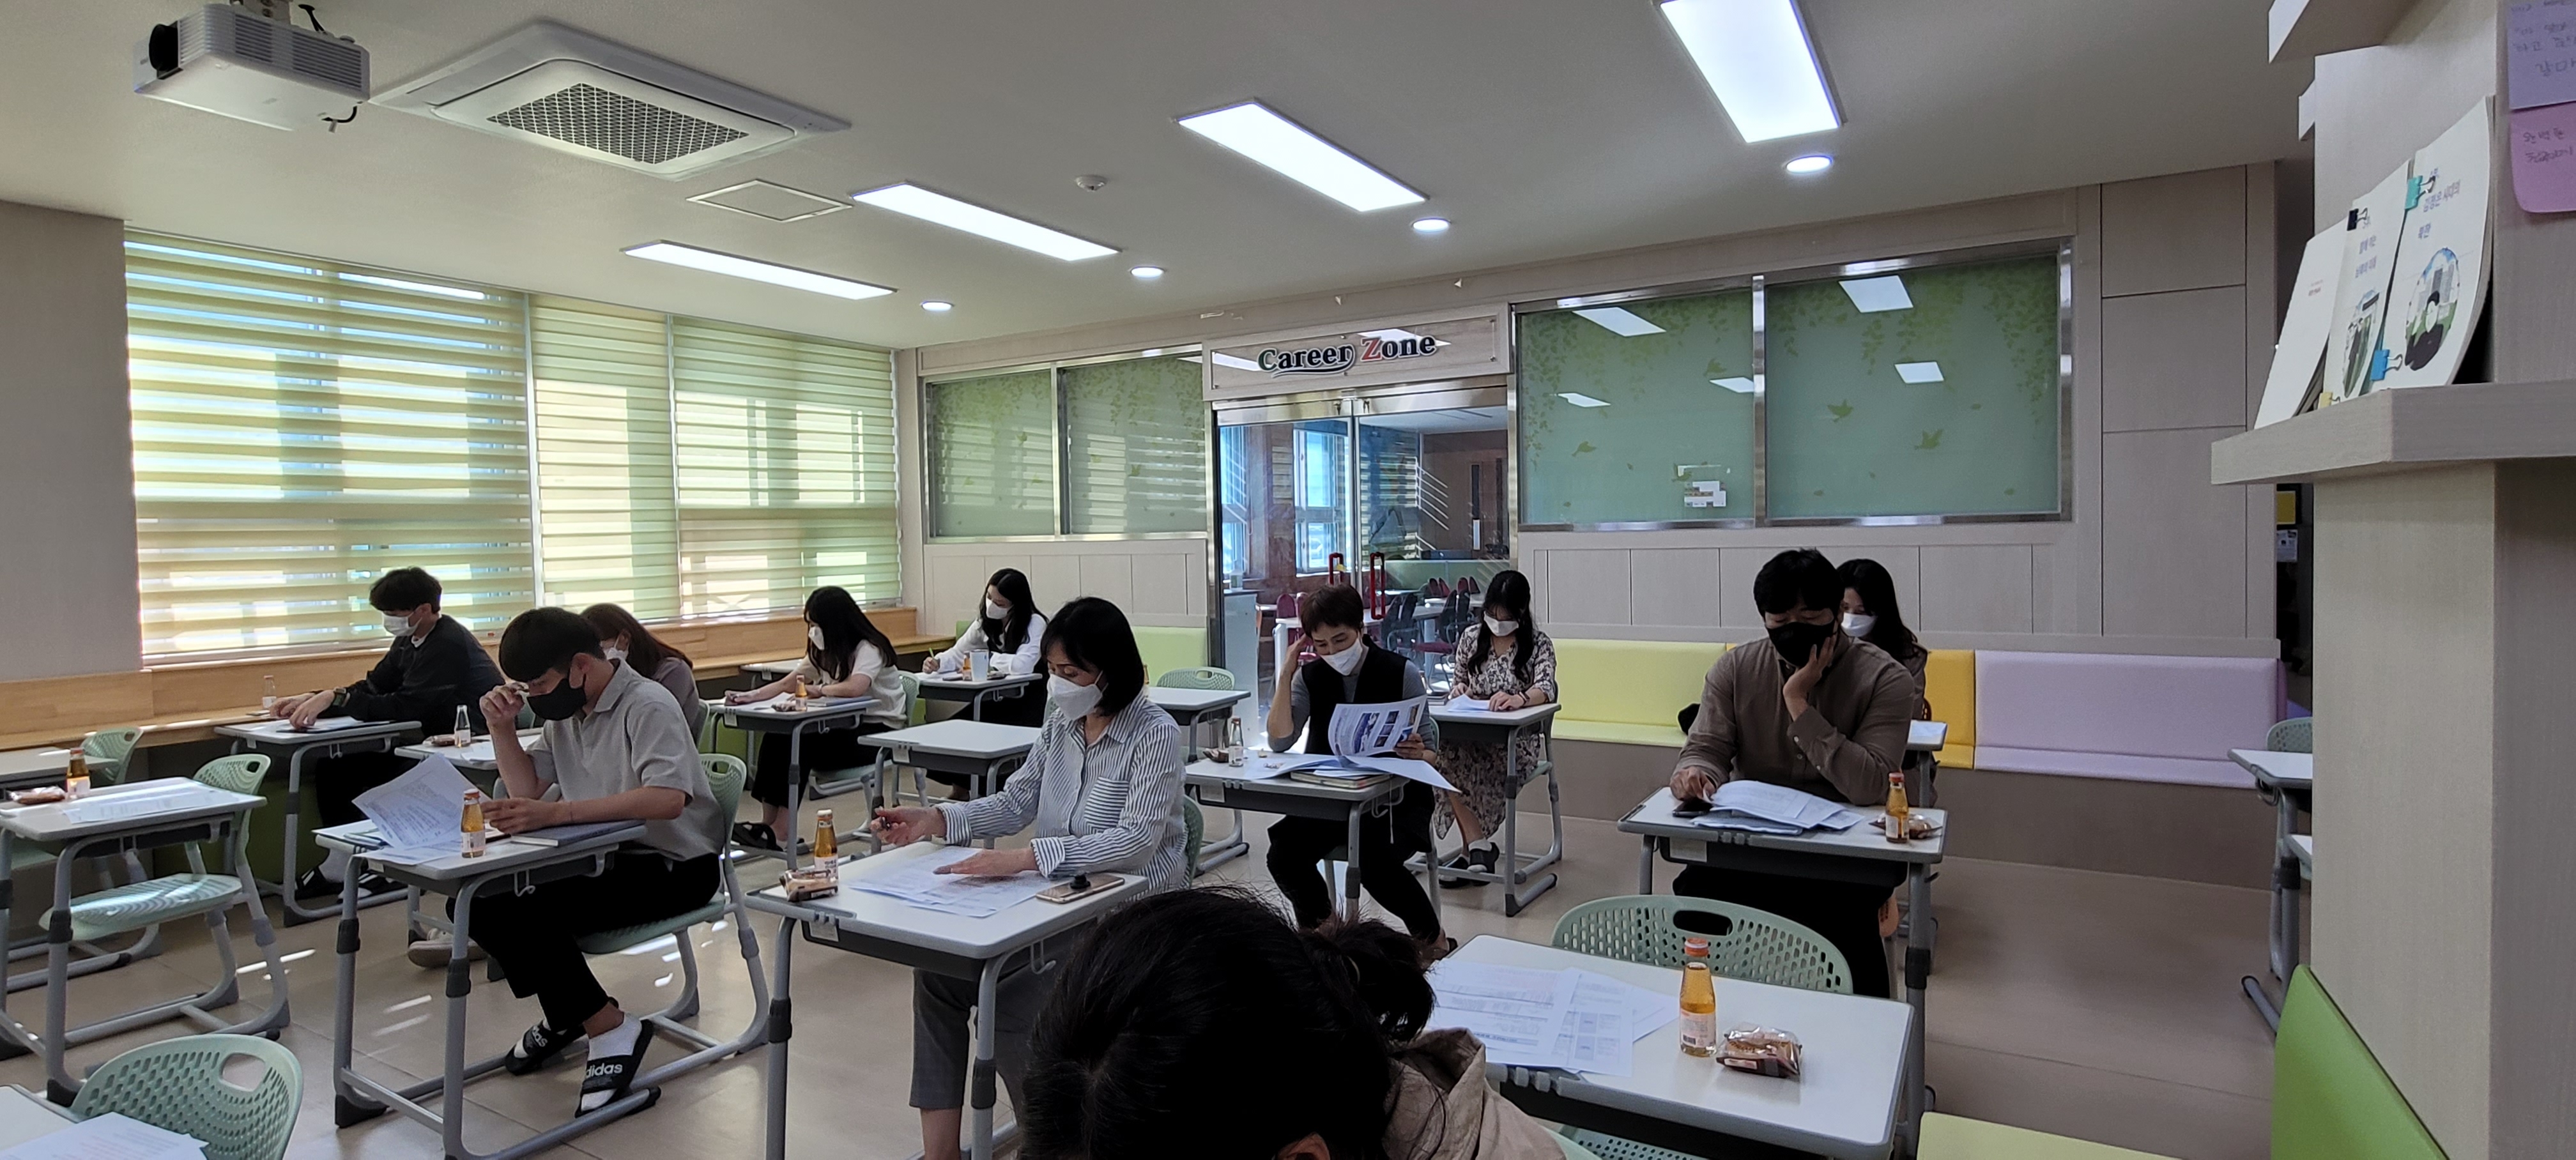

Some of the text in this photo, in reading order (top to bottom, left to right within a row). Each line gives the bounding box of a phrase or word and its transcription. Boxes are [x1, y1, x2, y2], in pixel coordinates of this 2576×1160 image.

[1257, 335, 1436, 377] Career Zone
[586, 1062, 624, 1079] didas
